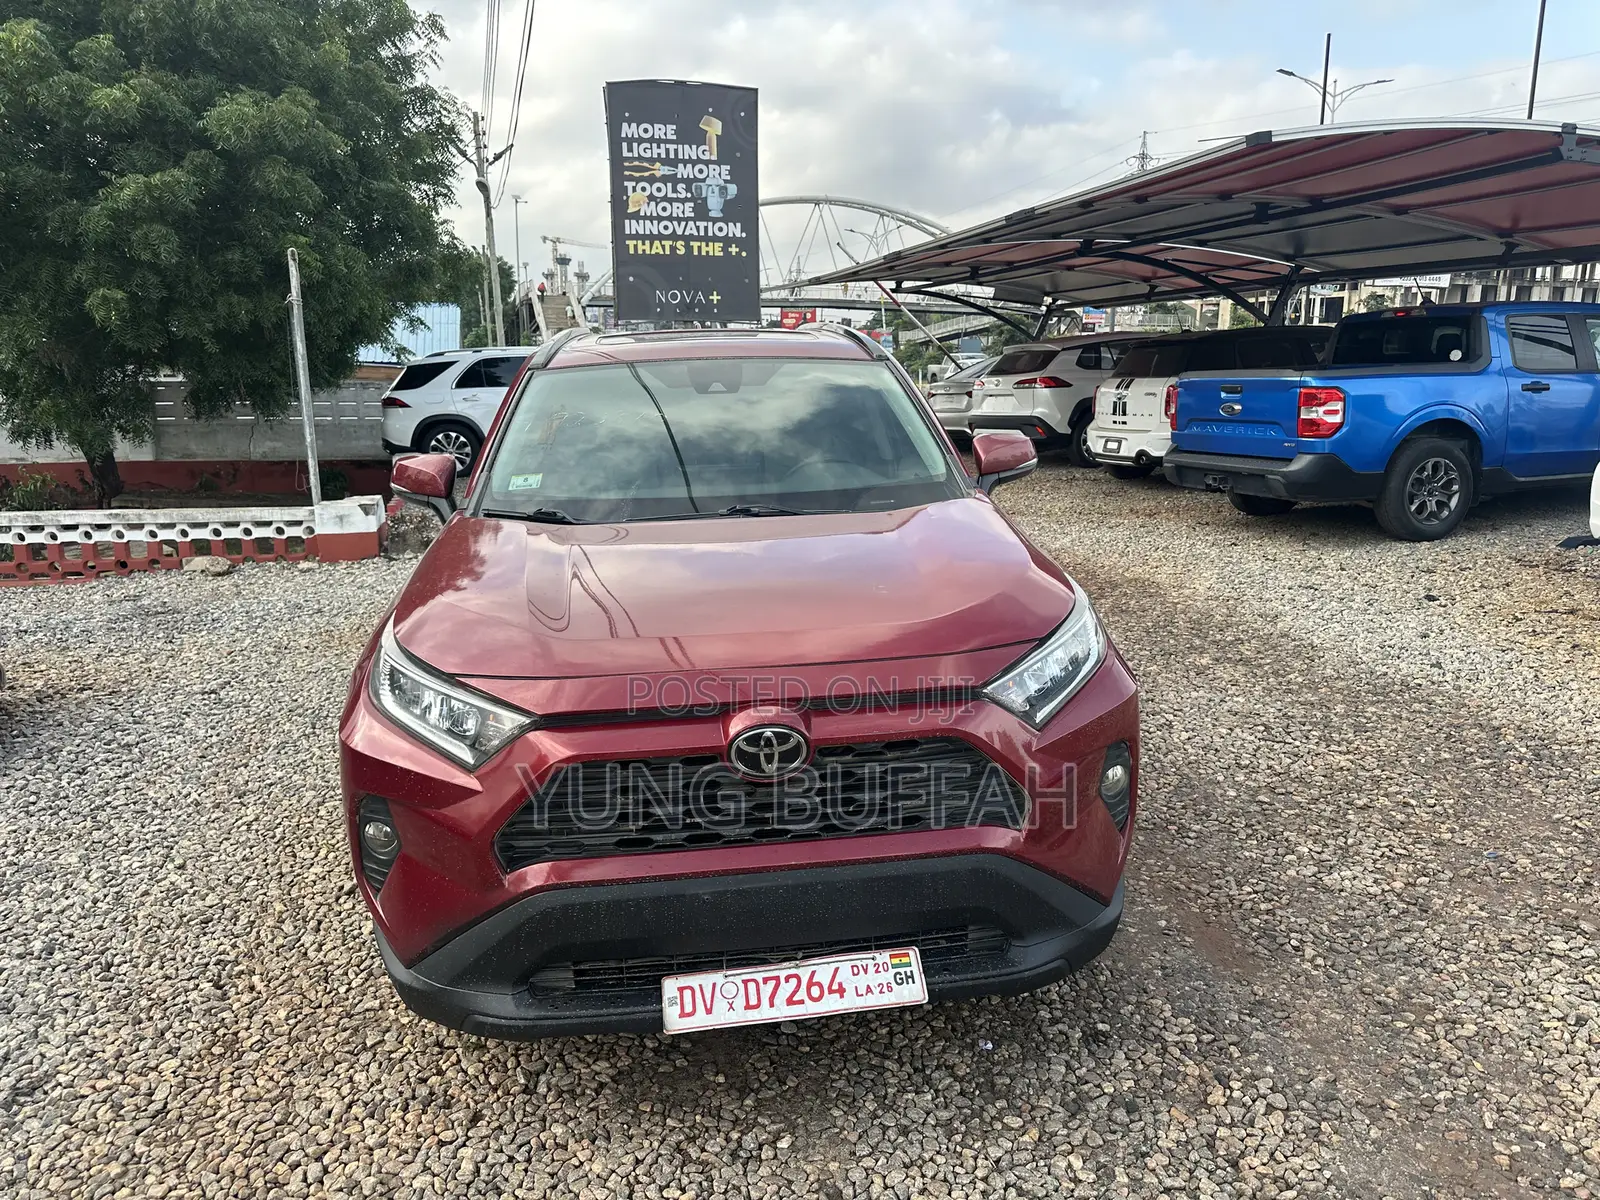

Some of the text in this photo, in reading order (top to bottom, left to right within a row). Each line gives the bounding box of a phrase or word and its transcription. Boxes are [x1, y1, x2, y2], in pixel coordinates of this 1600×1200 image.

[621, 122, 676, 139] MORE
[622, 142, 717, 160] LIGHTING.
[677, 163, 730, 180] MORE
[624, 181, 691, 199] TOOLS.
[640, 201, 694, 218] MORE
[624, 219, 746, 238] INNOVATION.
[626, 240, 685, 255] THAT'S
[690, 241, 723, 256] THE
[1191, 425, 1277, 436] MAVERICK
[850, 961, 889, 976] DV 20
[893, 970, 916, 986] GH
[677, 966, 846, 1018] DV D7264
[854, 981, 893, 997] LA 26
